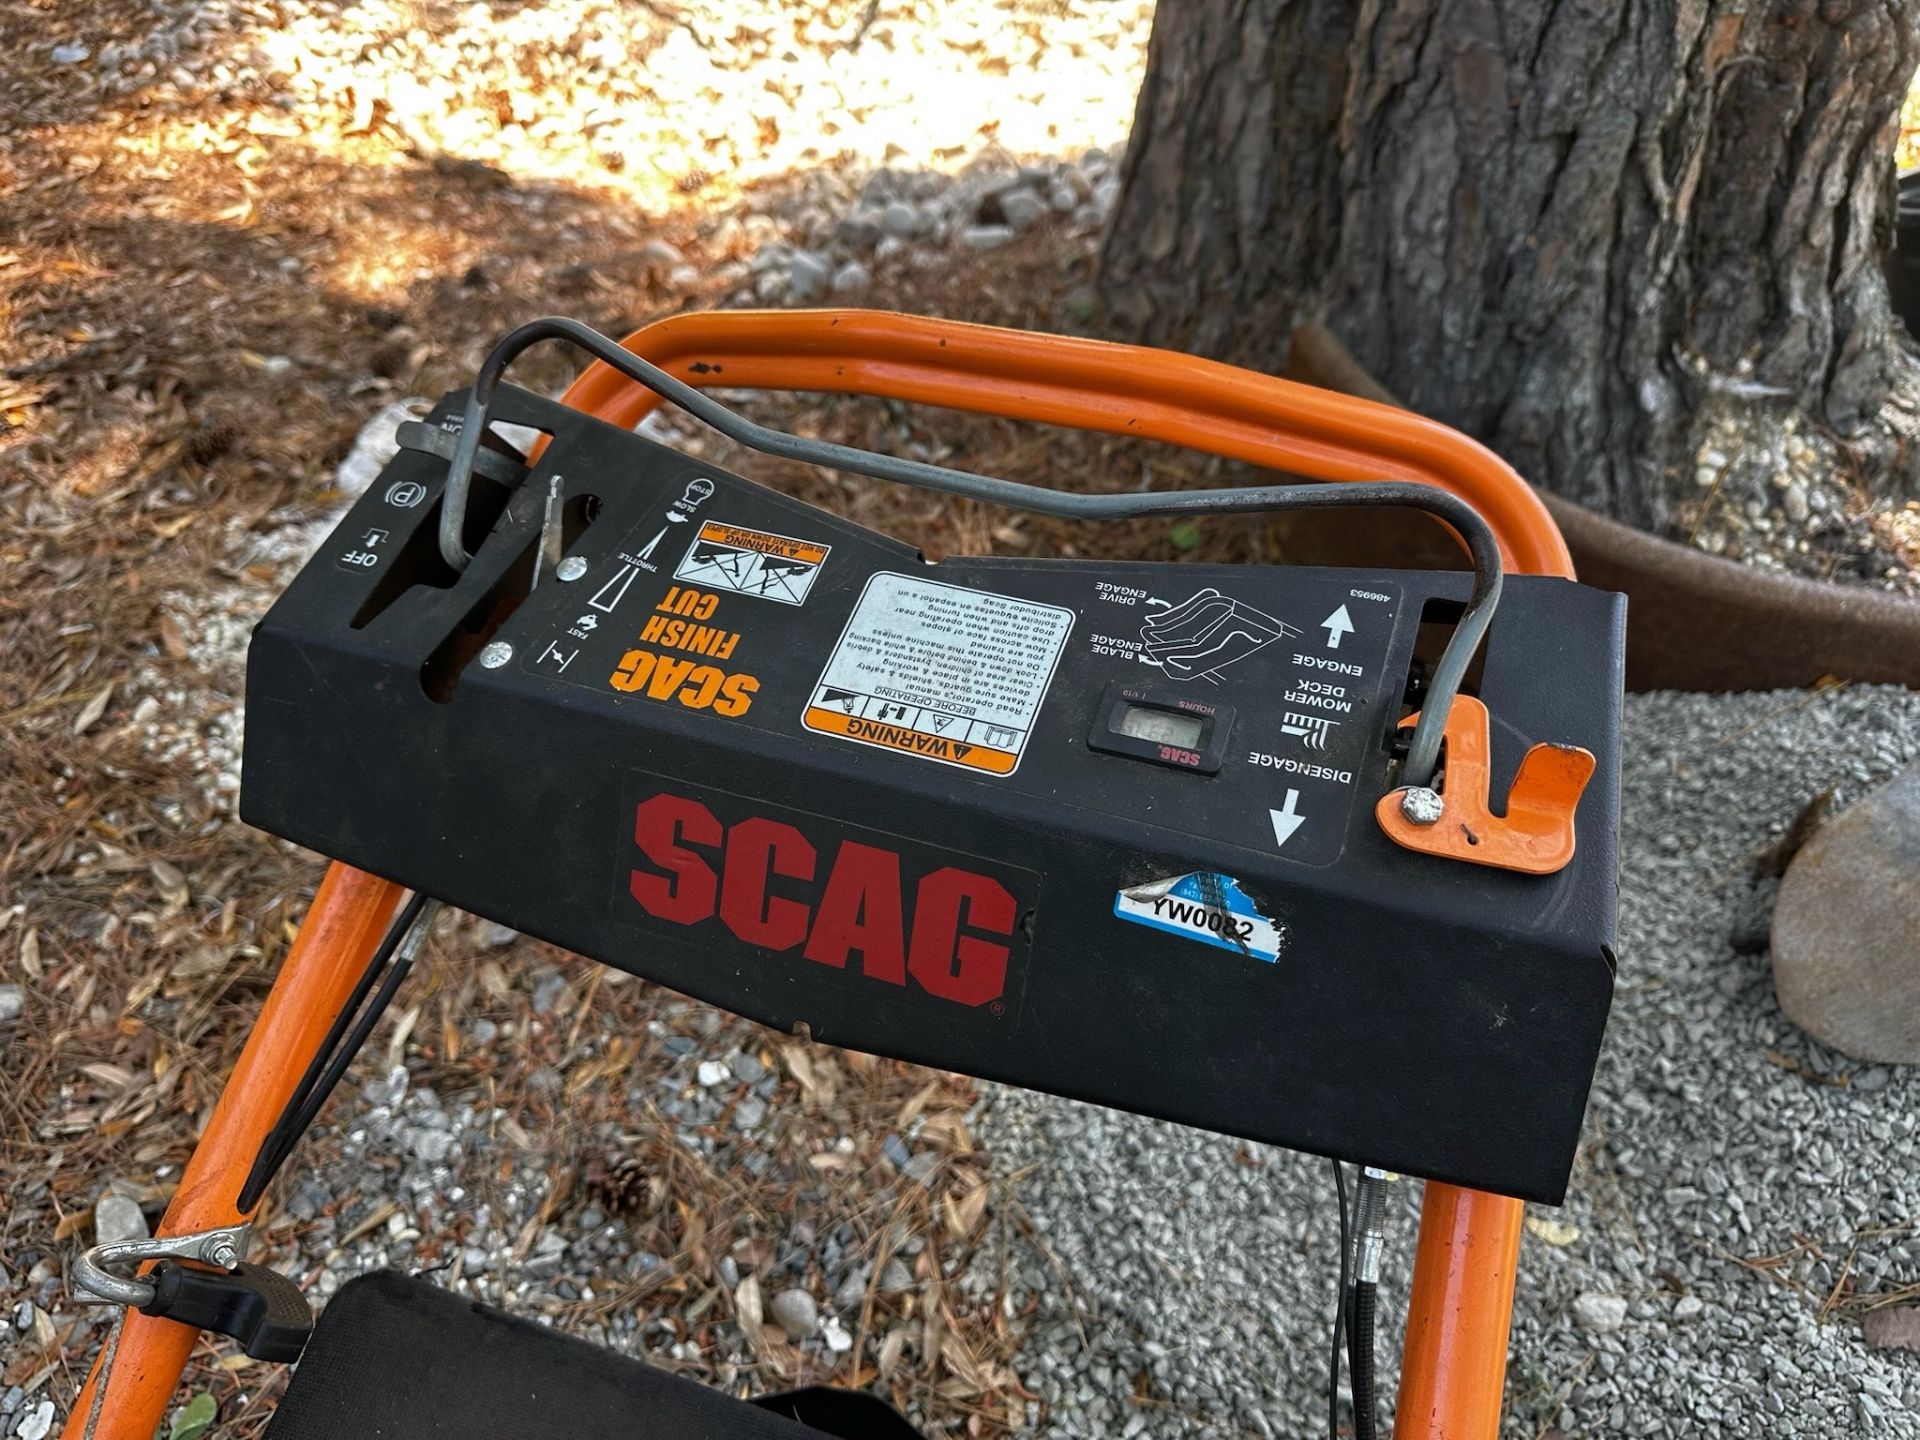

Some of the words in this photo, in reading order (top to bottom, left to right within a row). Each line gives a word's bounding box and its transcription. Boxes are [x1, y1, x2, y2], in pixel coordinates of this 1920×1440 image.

[689, 482, 710, 496] STOP
[672, 499, 698, 512] SLOW
[722, 533, 784, 555] WARNING
[341, 550, 377, 566] OFF
[617, 552, 657, 572] THROTTLE
[1094, 581, 1146, 598] ENGAGE
[1350, 589, 1390, 602] 486953
[655, 586, 719, 620] CUT
[919, 594, 956, 606] español
[982, 598, 1006, 609] Scag
[1098, 591, 1135, 605] DRIVE
[894, 607, 915, 615] near
[927, 603, 960, 616] turning
[918, 610, 962, 625] operating
[963, 612, 987, 622] when
[990, 618, 1008, 626] and
[1020, 616, 1057, 628] Solicite
[921, 621, 951, 632] slopes
[965, 622, 989, 631] when
[1011, 622, 1029, 630] offs
[1032, 626, 1054, 636] drop
[566, 627, 589, 639] FAST
[639, 615, 740, 659] FINISH
[848, 632, 881, 645] backing
[872, 629, 902, 639] unless
[966, 631, 986, 640] face
[993, 628, 1028, 639] caution
[883, 640, 905, 649] while
[905, 636, 944, 649] machine
[990, 636, 1022, 647] across
[1031, 635, 1049, 645] Use
[1089, 633, 1143, 651] ENGAGE
[846, 642, 873, 652] debris
[947, 645, 964, 654] this
[970, 641, 1004, 653] trained
[1024, 644, 1046, 653] Mow
[1091, 643, 1133, 659] BLADE
[884, 650, 932, 666] bystanders
[917, 648, 945, 659] before
[967, 650, 1004, 661] operate
[1026, 653, 1044, 661] you
[882, 658, 918, 671] working
[947, 654, 977, 666] behind
[1007, 658, 1023, 666] not
[1291, 653, 1362, 676] ENGAGE
[856, 662, 885, 673] safety
[989, 663, 1012, 673] down
[1026, 662, 1040, 671] Do
[898, 672, 932, 684] shields
[932, 670, 958, 680] place
[986, 672, 1006, 681] area
[1015, 669, 1037, 679] Look
[609, 649, 760, 717] SCAG
[973, 679, 989, 687] are
[1008, 677, 1033, 688] Clear
[1296, 679, 1345, 697] DECK
[873, 685, 931, 705] OPERATING
[905, 683, 941, 695] manual
[974, 689, 996, 698] sure
[992, 683, 1030, 696] devices
[999, 695, 1025, 706] Make
[1283, 690, 1351, 712] MOWER
[933, 699, 976, 716] BEFORE
[995, 703, 1022, 715] Read
[1178, 700, 1215, 714] HOURS
[846, 718, 948, 756] WARNING
[1160, 746, 1200, 766] SCAG
[1247, 751, 1351, 783] DISENGAGE
[629, 792, 1016, 1006] SCAG
[1152, 898, 1254, 942] YW0082
